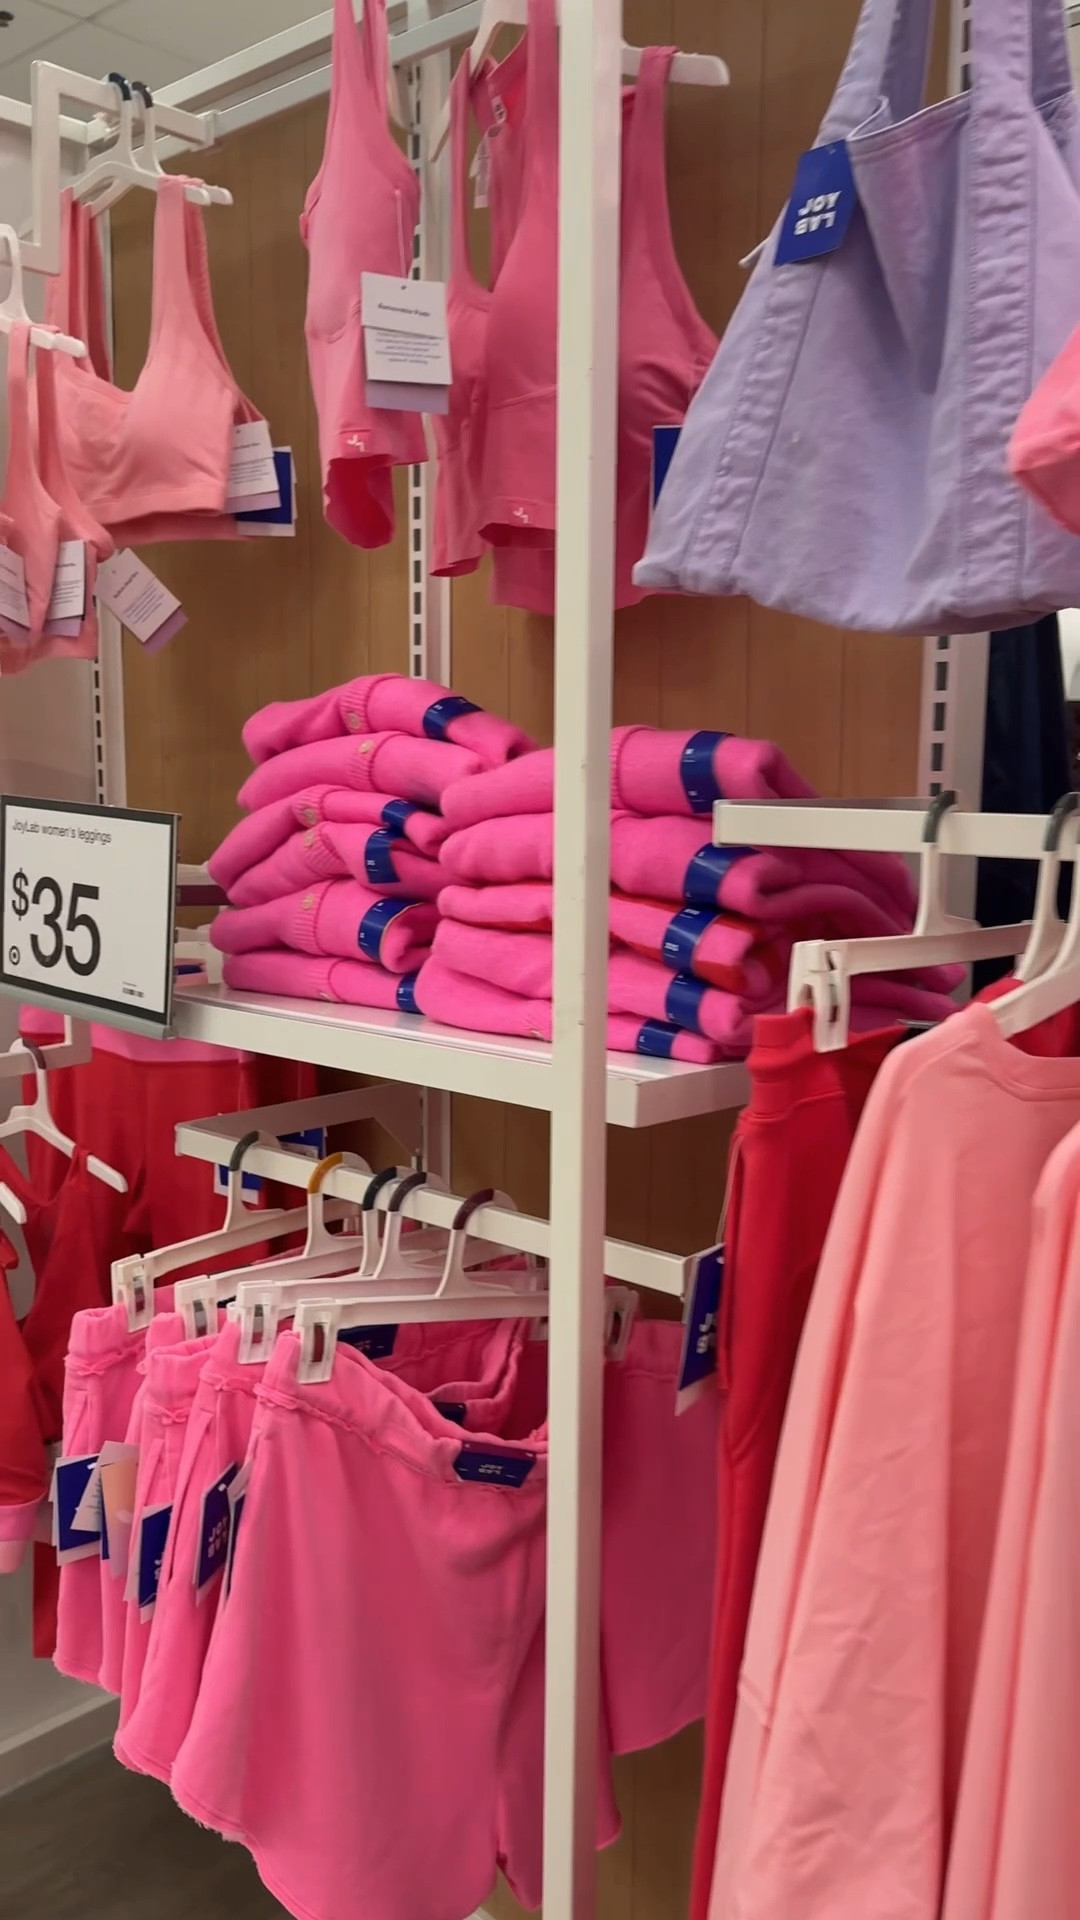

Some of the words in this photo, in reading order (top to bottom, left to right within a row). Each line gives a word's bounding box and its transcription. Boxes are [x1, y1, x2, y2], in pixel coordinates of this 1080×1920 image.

[798, 190, 842, 217] JOY
[793, 210, 837, 236] LAB
[12, 819, 40, 835] JoyLab
[41, 825, 76, 839] women's
[77, 828, 112, 846] leggings
[11, 867, 101, 977] $35
